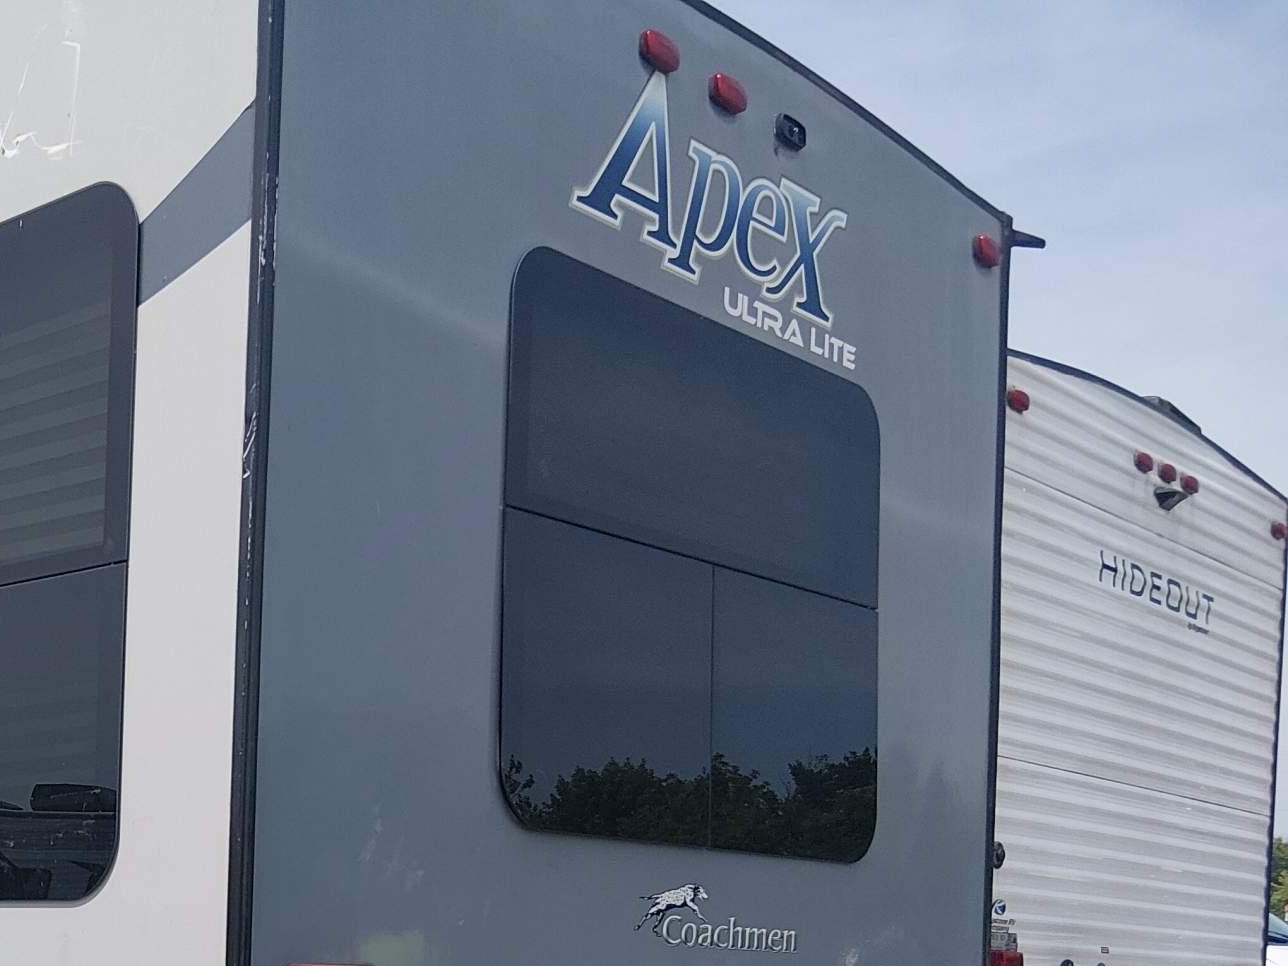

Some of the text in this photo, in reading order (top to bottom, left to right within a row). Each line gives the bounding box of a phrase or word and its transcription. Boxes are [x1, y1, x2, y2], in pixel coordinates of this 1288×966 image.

[569, 67, 848, 328] Apex
[723, 285, 857, 371] ULTRA LITE
[1098, 549, 1215, 625] HIDEOUT
[661, 914, 798, 954] Coachmen
